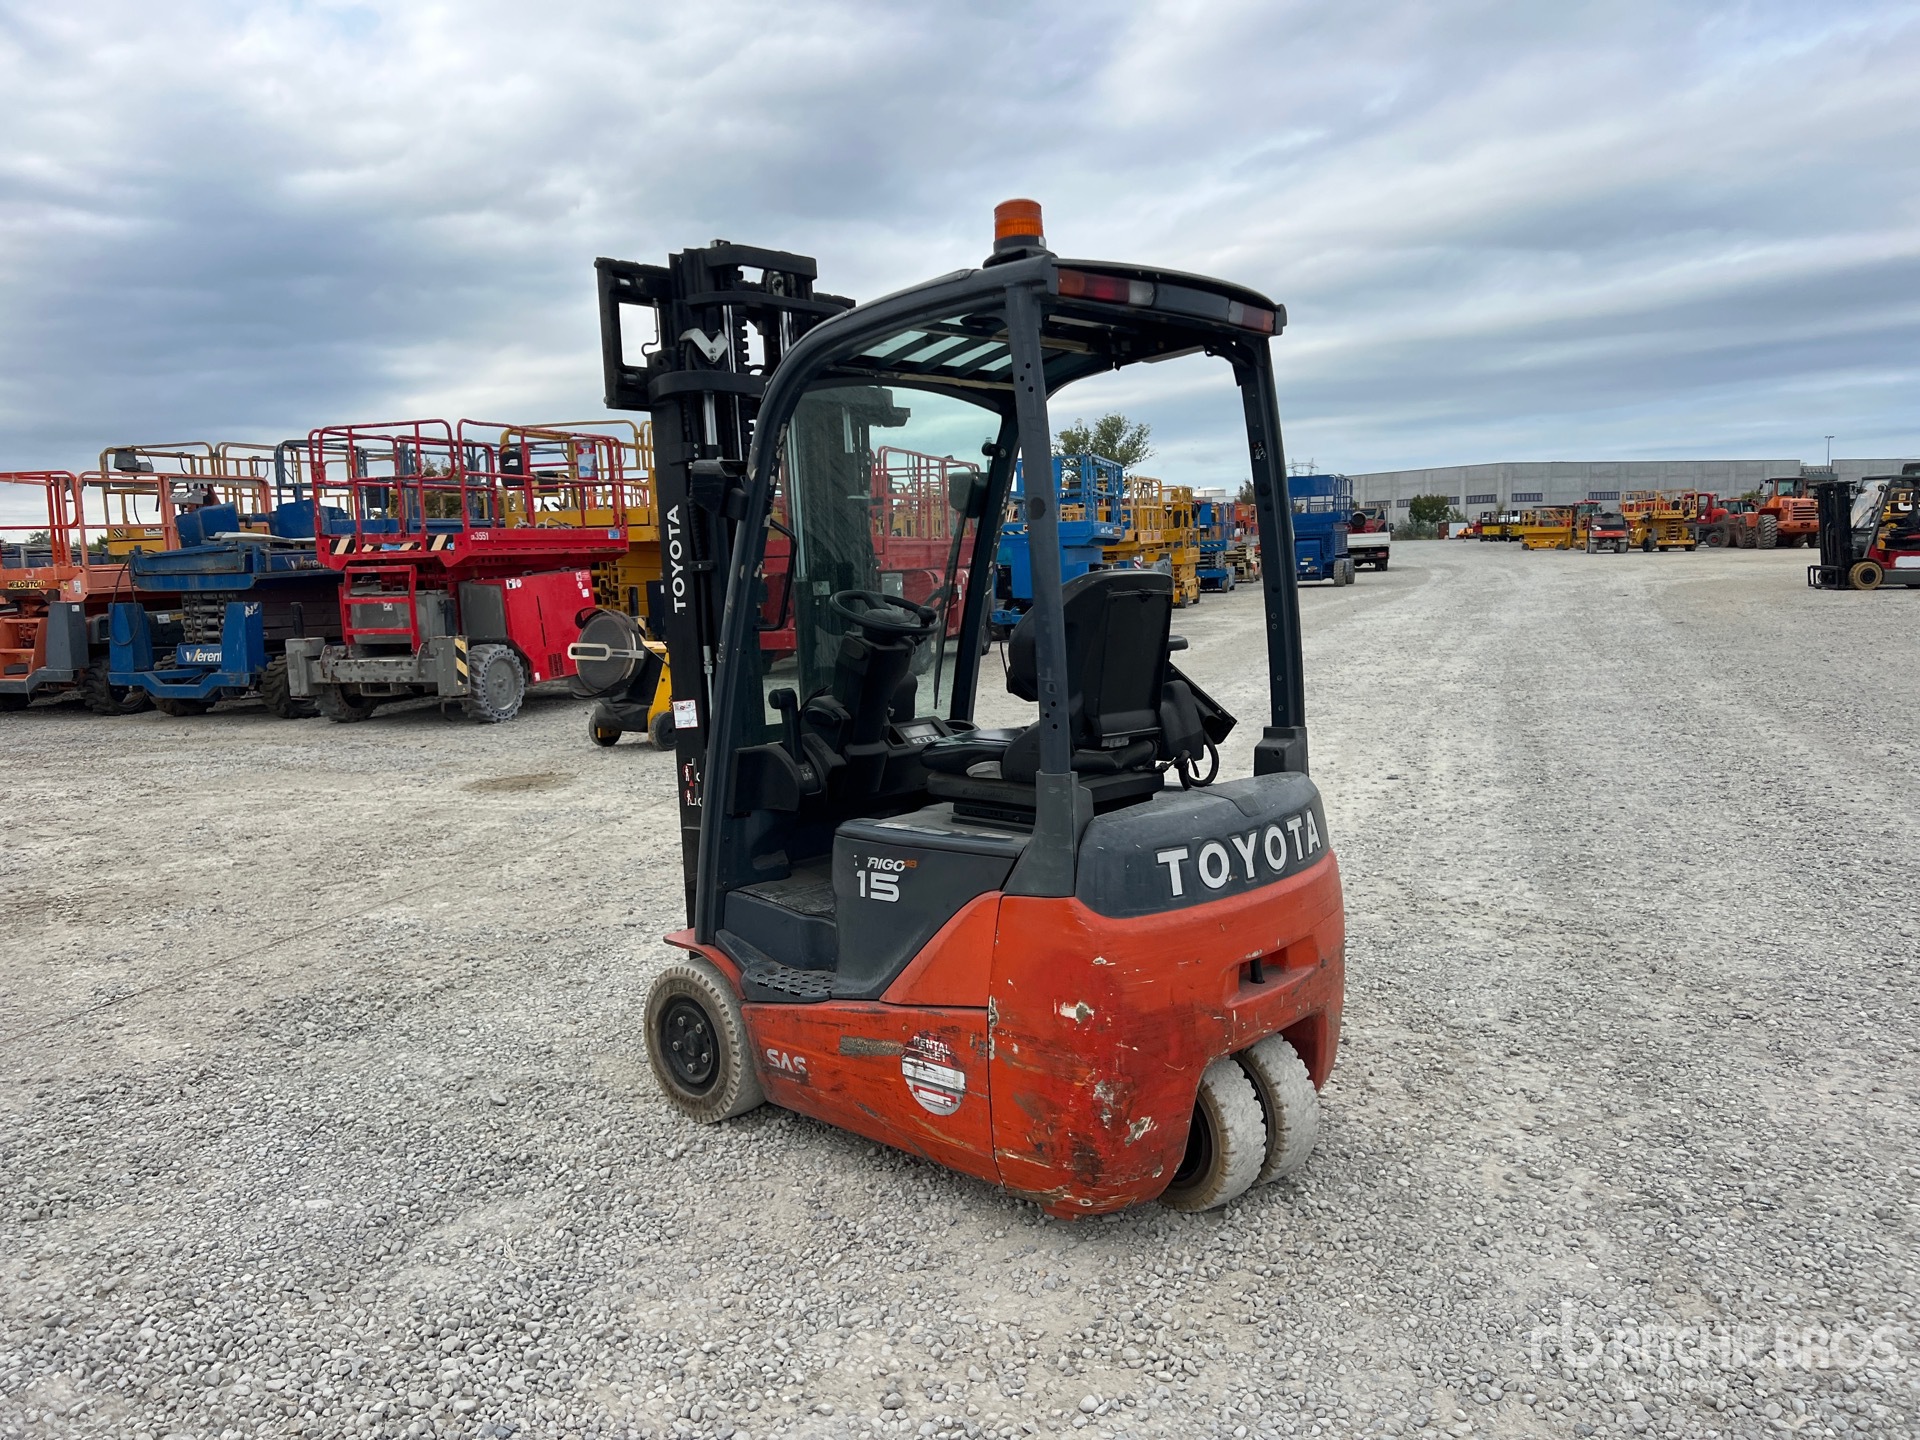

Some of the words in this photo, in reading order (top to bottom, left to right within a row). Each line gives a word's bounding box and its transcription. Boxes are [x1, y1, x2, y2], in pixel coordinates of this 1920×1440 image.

[667, 504, 687, 614] TOYOTA
[1157, 810, 1321, 896] TOYOTA
[856, 870, 900, 902] 15
[913, 1035, 951, 1055] RENTAL
[766, 1048, 807, 1075] SAS
